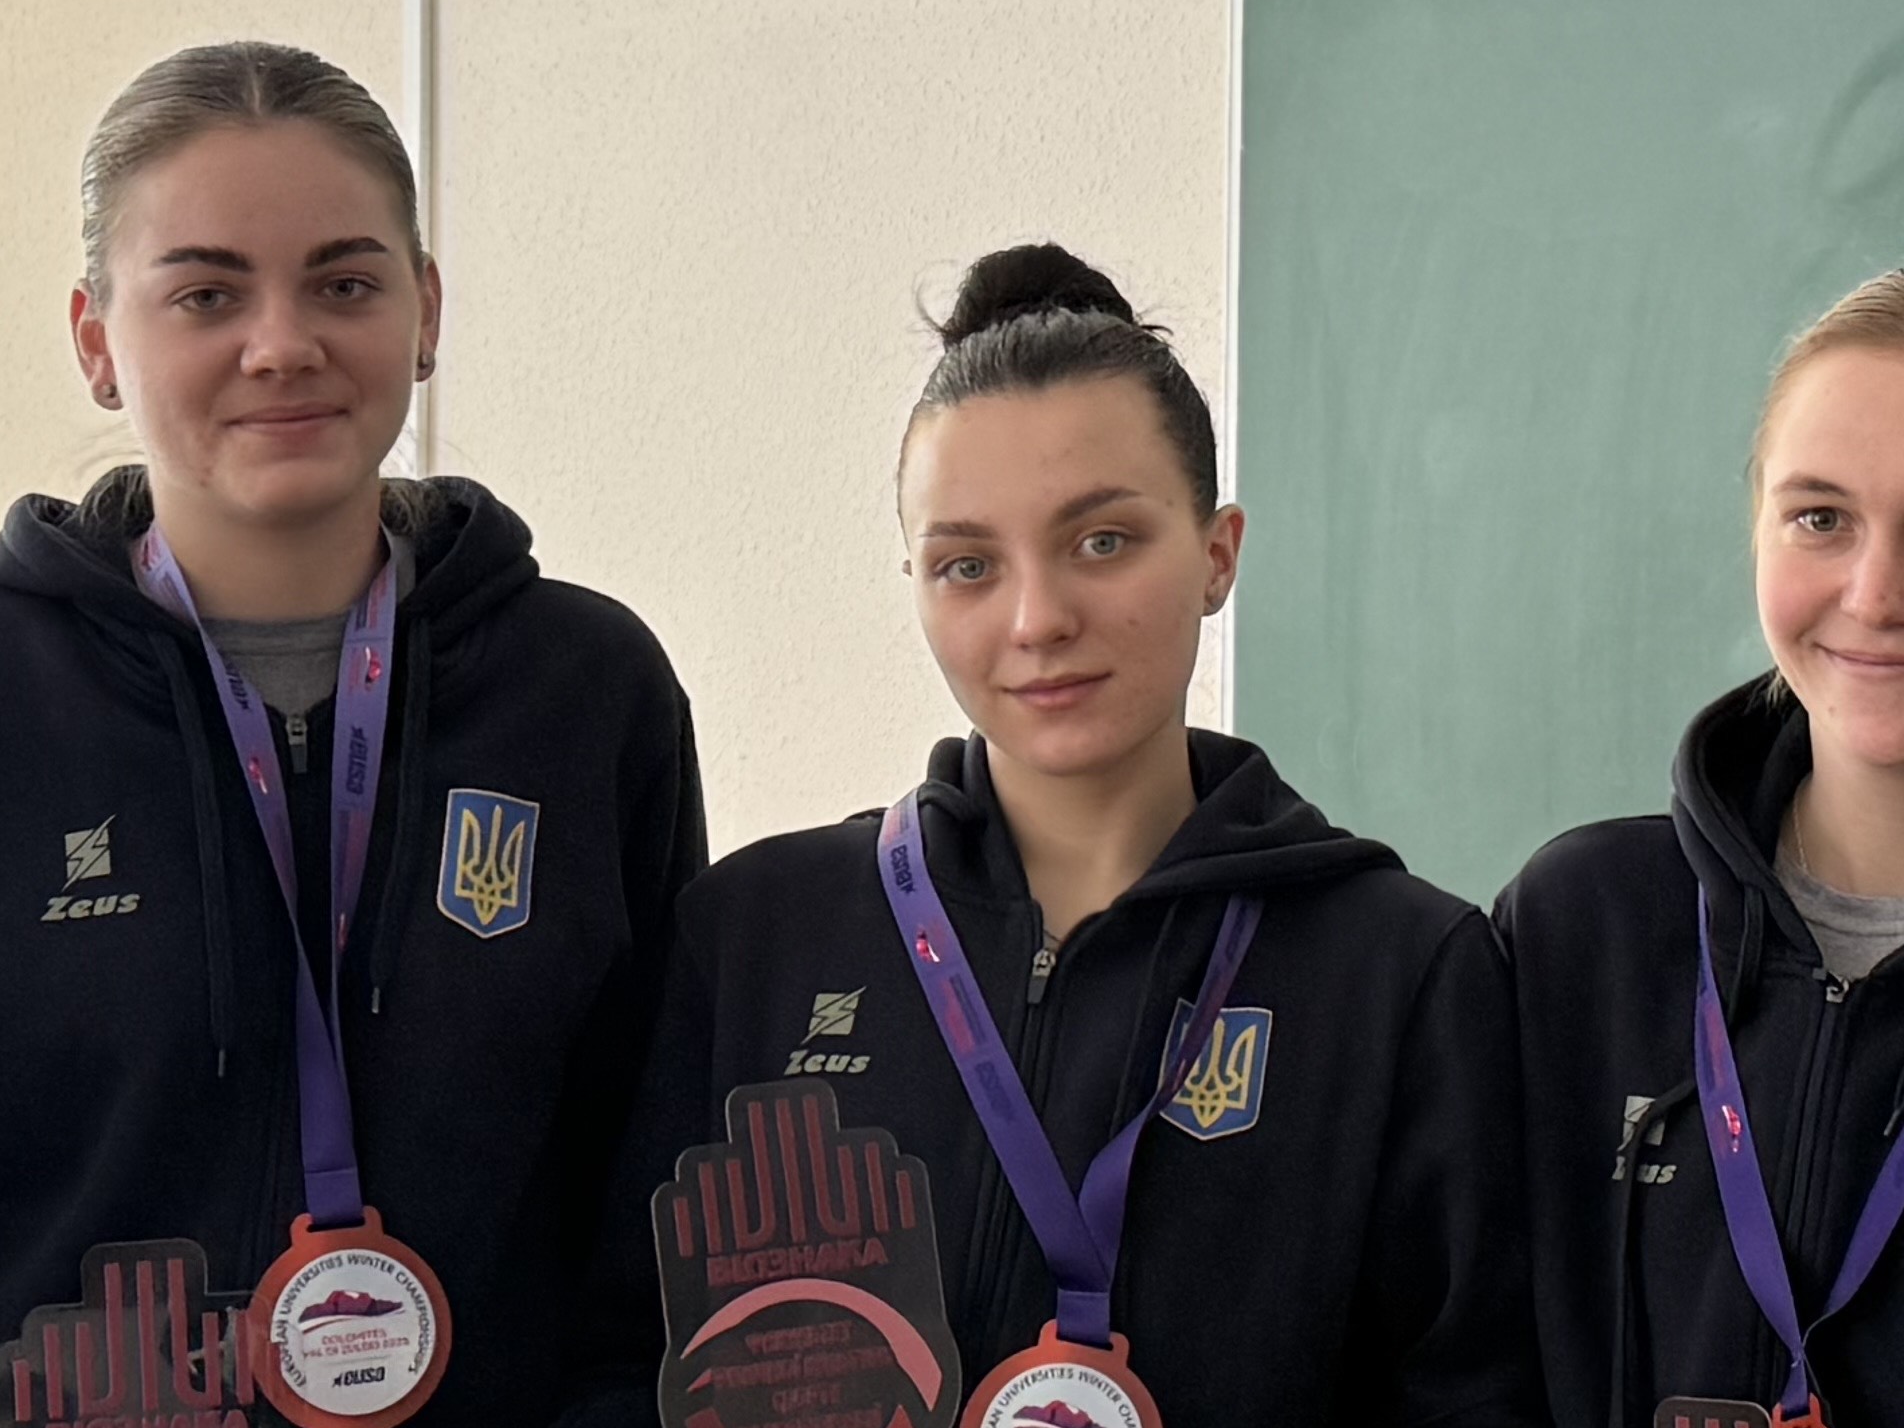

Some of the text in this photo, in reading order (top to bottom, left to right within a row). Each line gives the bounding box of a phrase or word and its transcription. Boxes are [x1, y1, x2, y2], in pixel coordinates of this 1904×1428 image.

[40, 886, 141, 921] Zeus
[784, 1050, 871, 1076] Zeus
[346, 1254, 395, 1273] WINTER
[1078, 1370, 1122, 1404] WINTER
